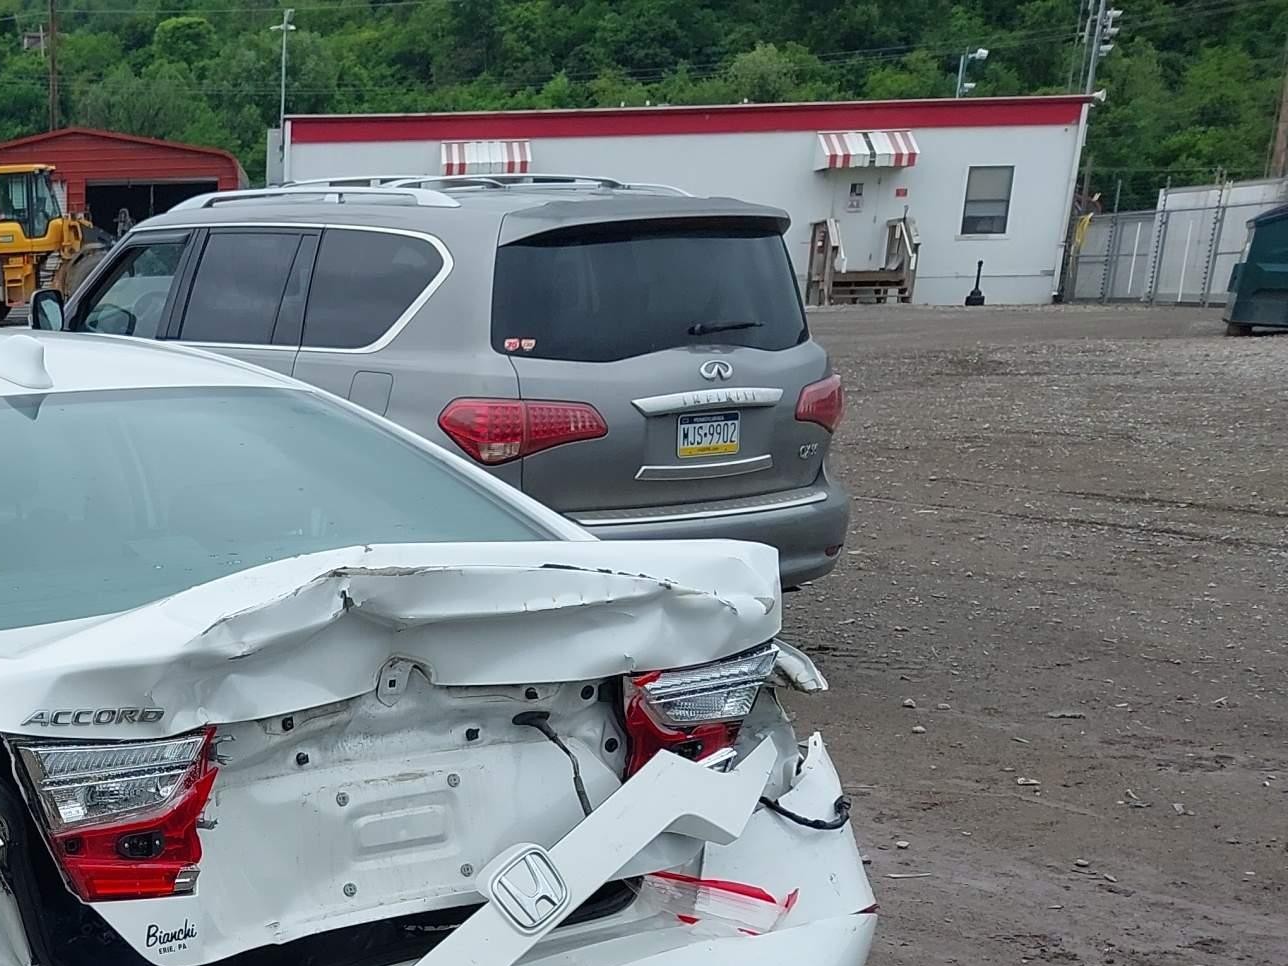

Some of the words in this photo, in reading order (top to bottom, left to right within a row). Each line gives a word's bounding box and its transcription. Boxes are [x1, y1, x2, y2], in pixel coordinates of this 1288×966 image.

[21, 707, 165, 727] ACCORD
[146, 918, 197, 948] Bianchi
[158, 946, 176, 955] ERIE,
